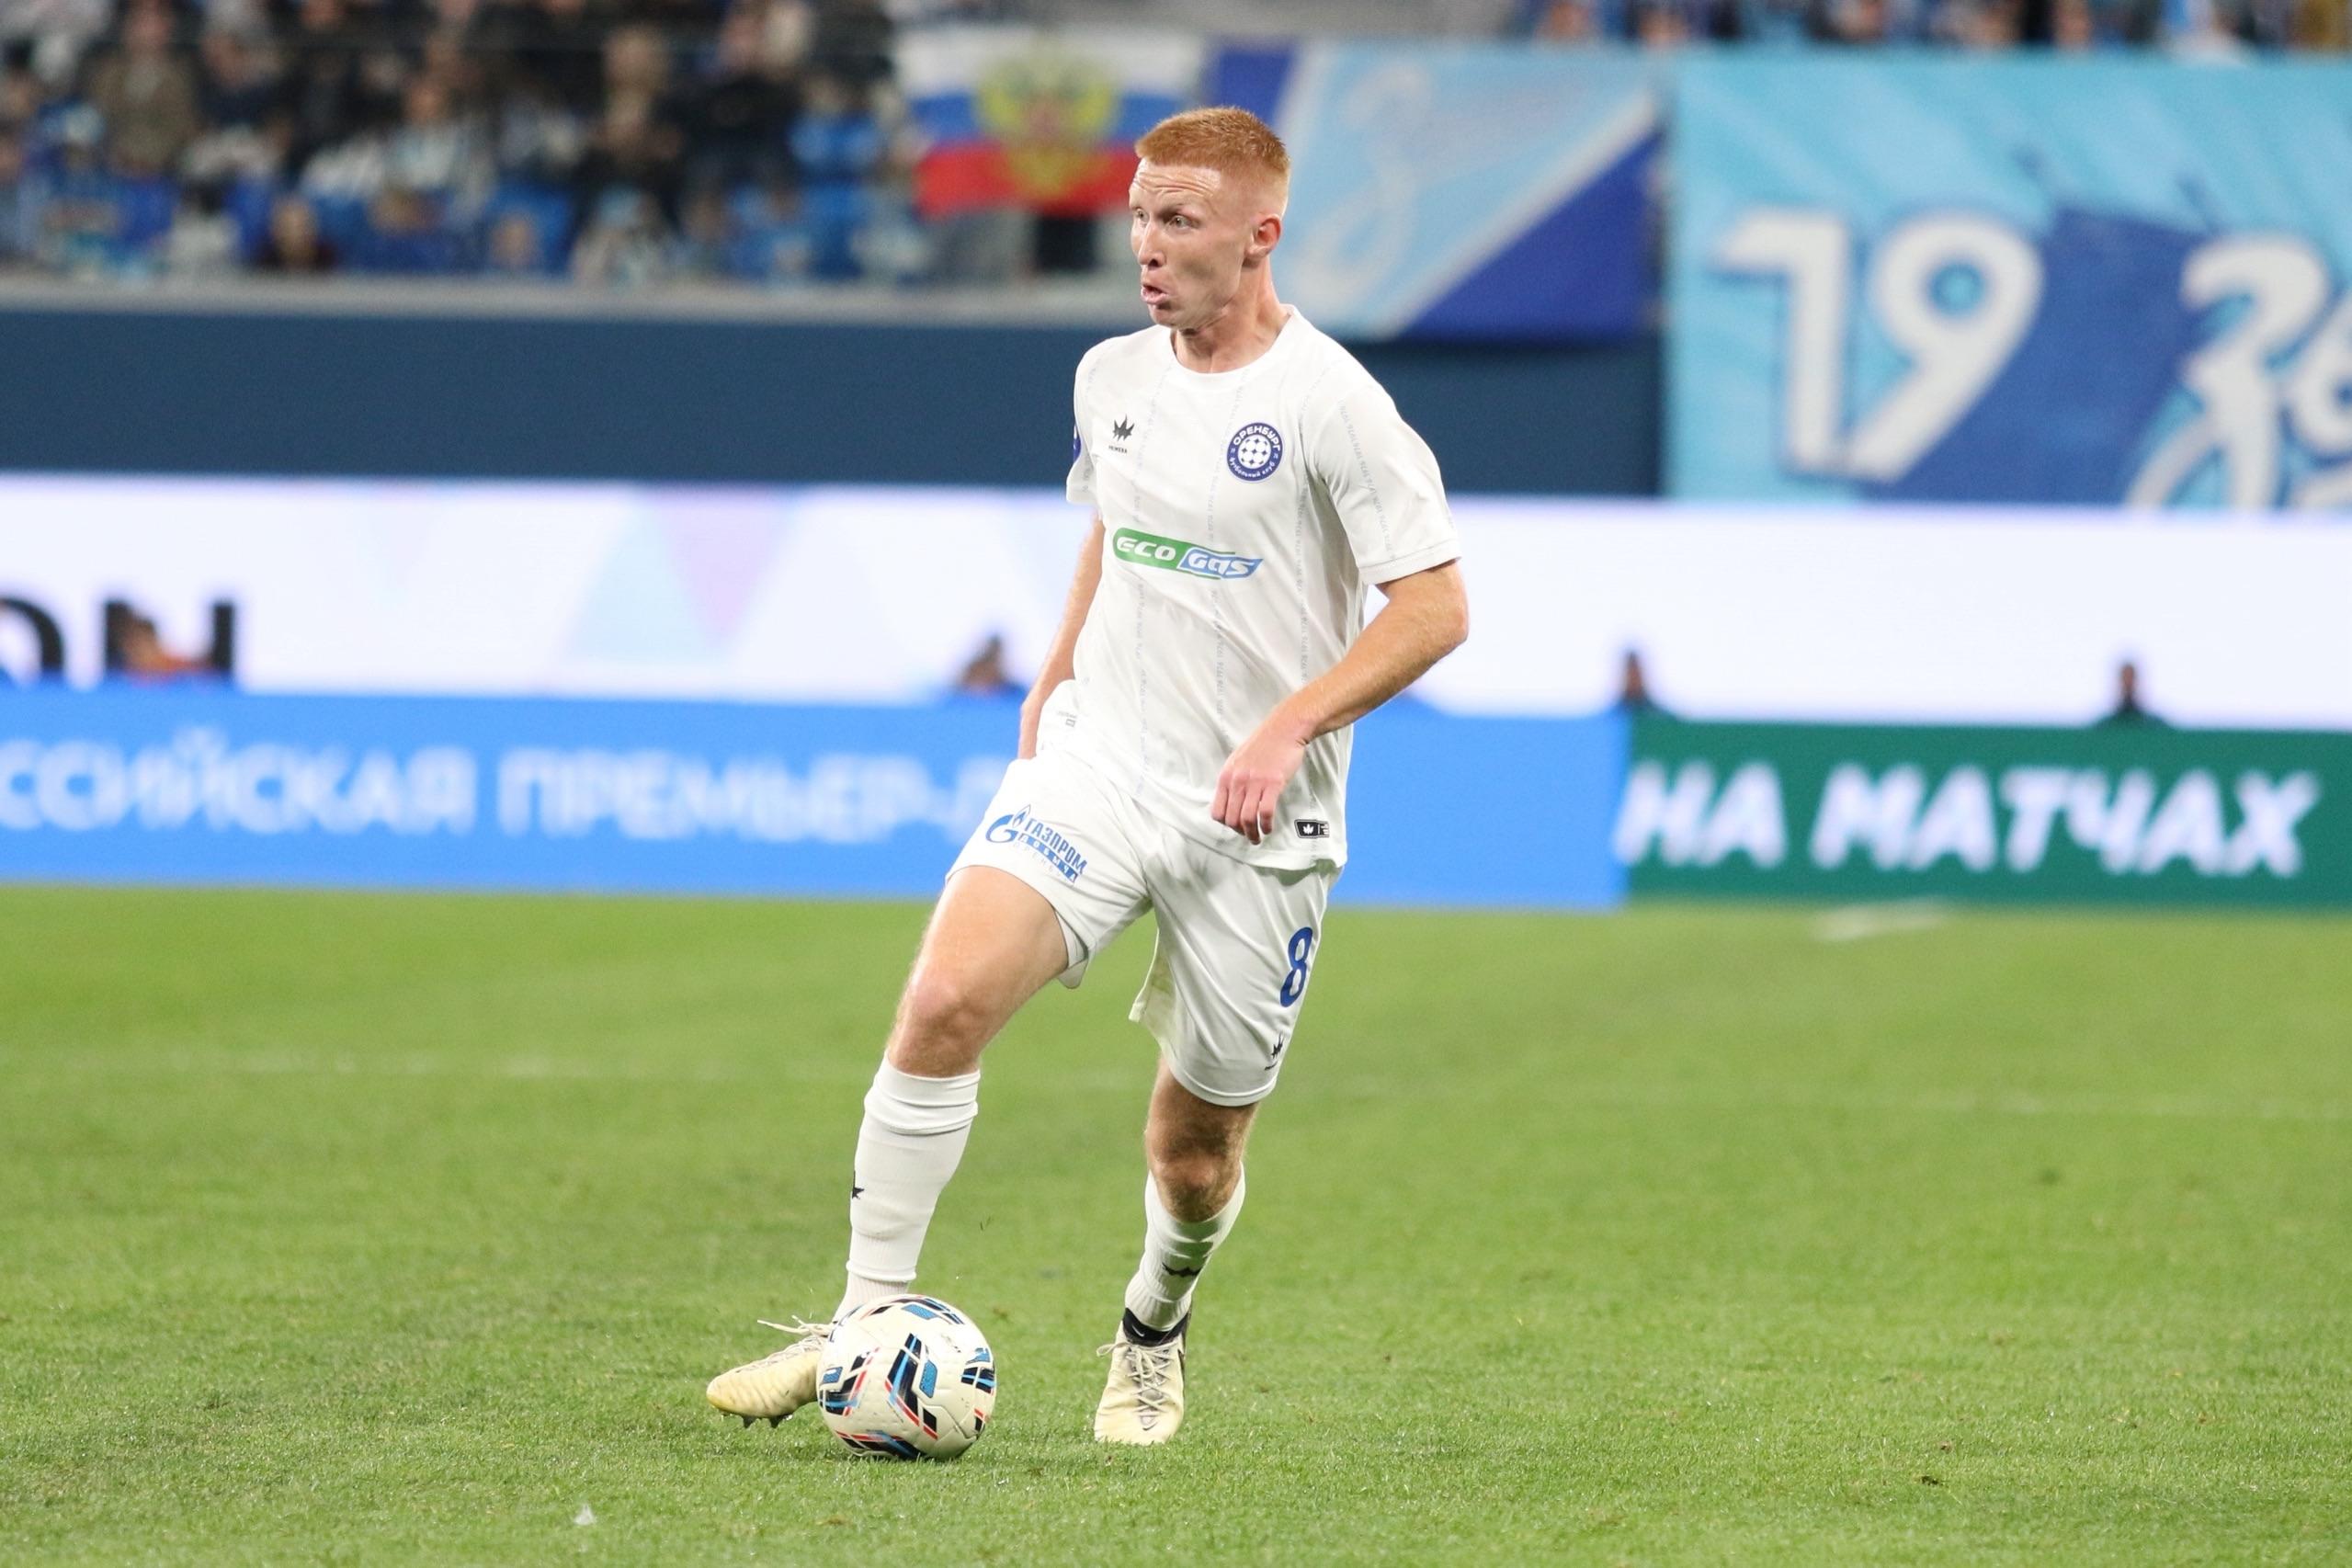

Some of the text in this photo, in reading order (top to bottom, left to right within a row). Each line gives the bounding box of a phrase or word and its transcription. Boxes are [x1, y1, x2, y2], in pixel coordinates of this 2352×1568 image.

[1233, 426, 1281, 451] ОРЕНБУРГ
[1024, 817, 1088, 875] ГАЗПРОМ
[1612, 756, 2322, 879] НА МАТЧАХ
[1279, 926, 1313, 1007] 8
